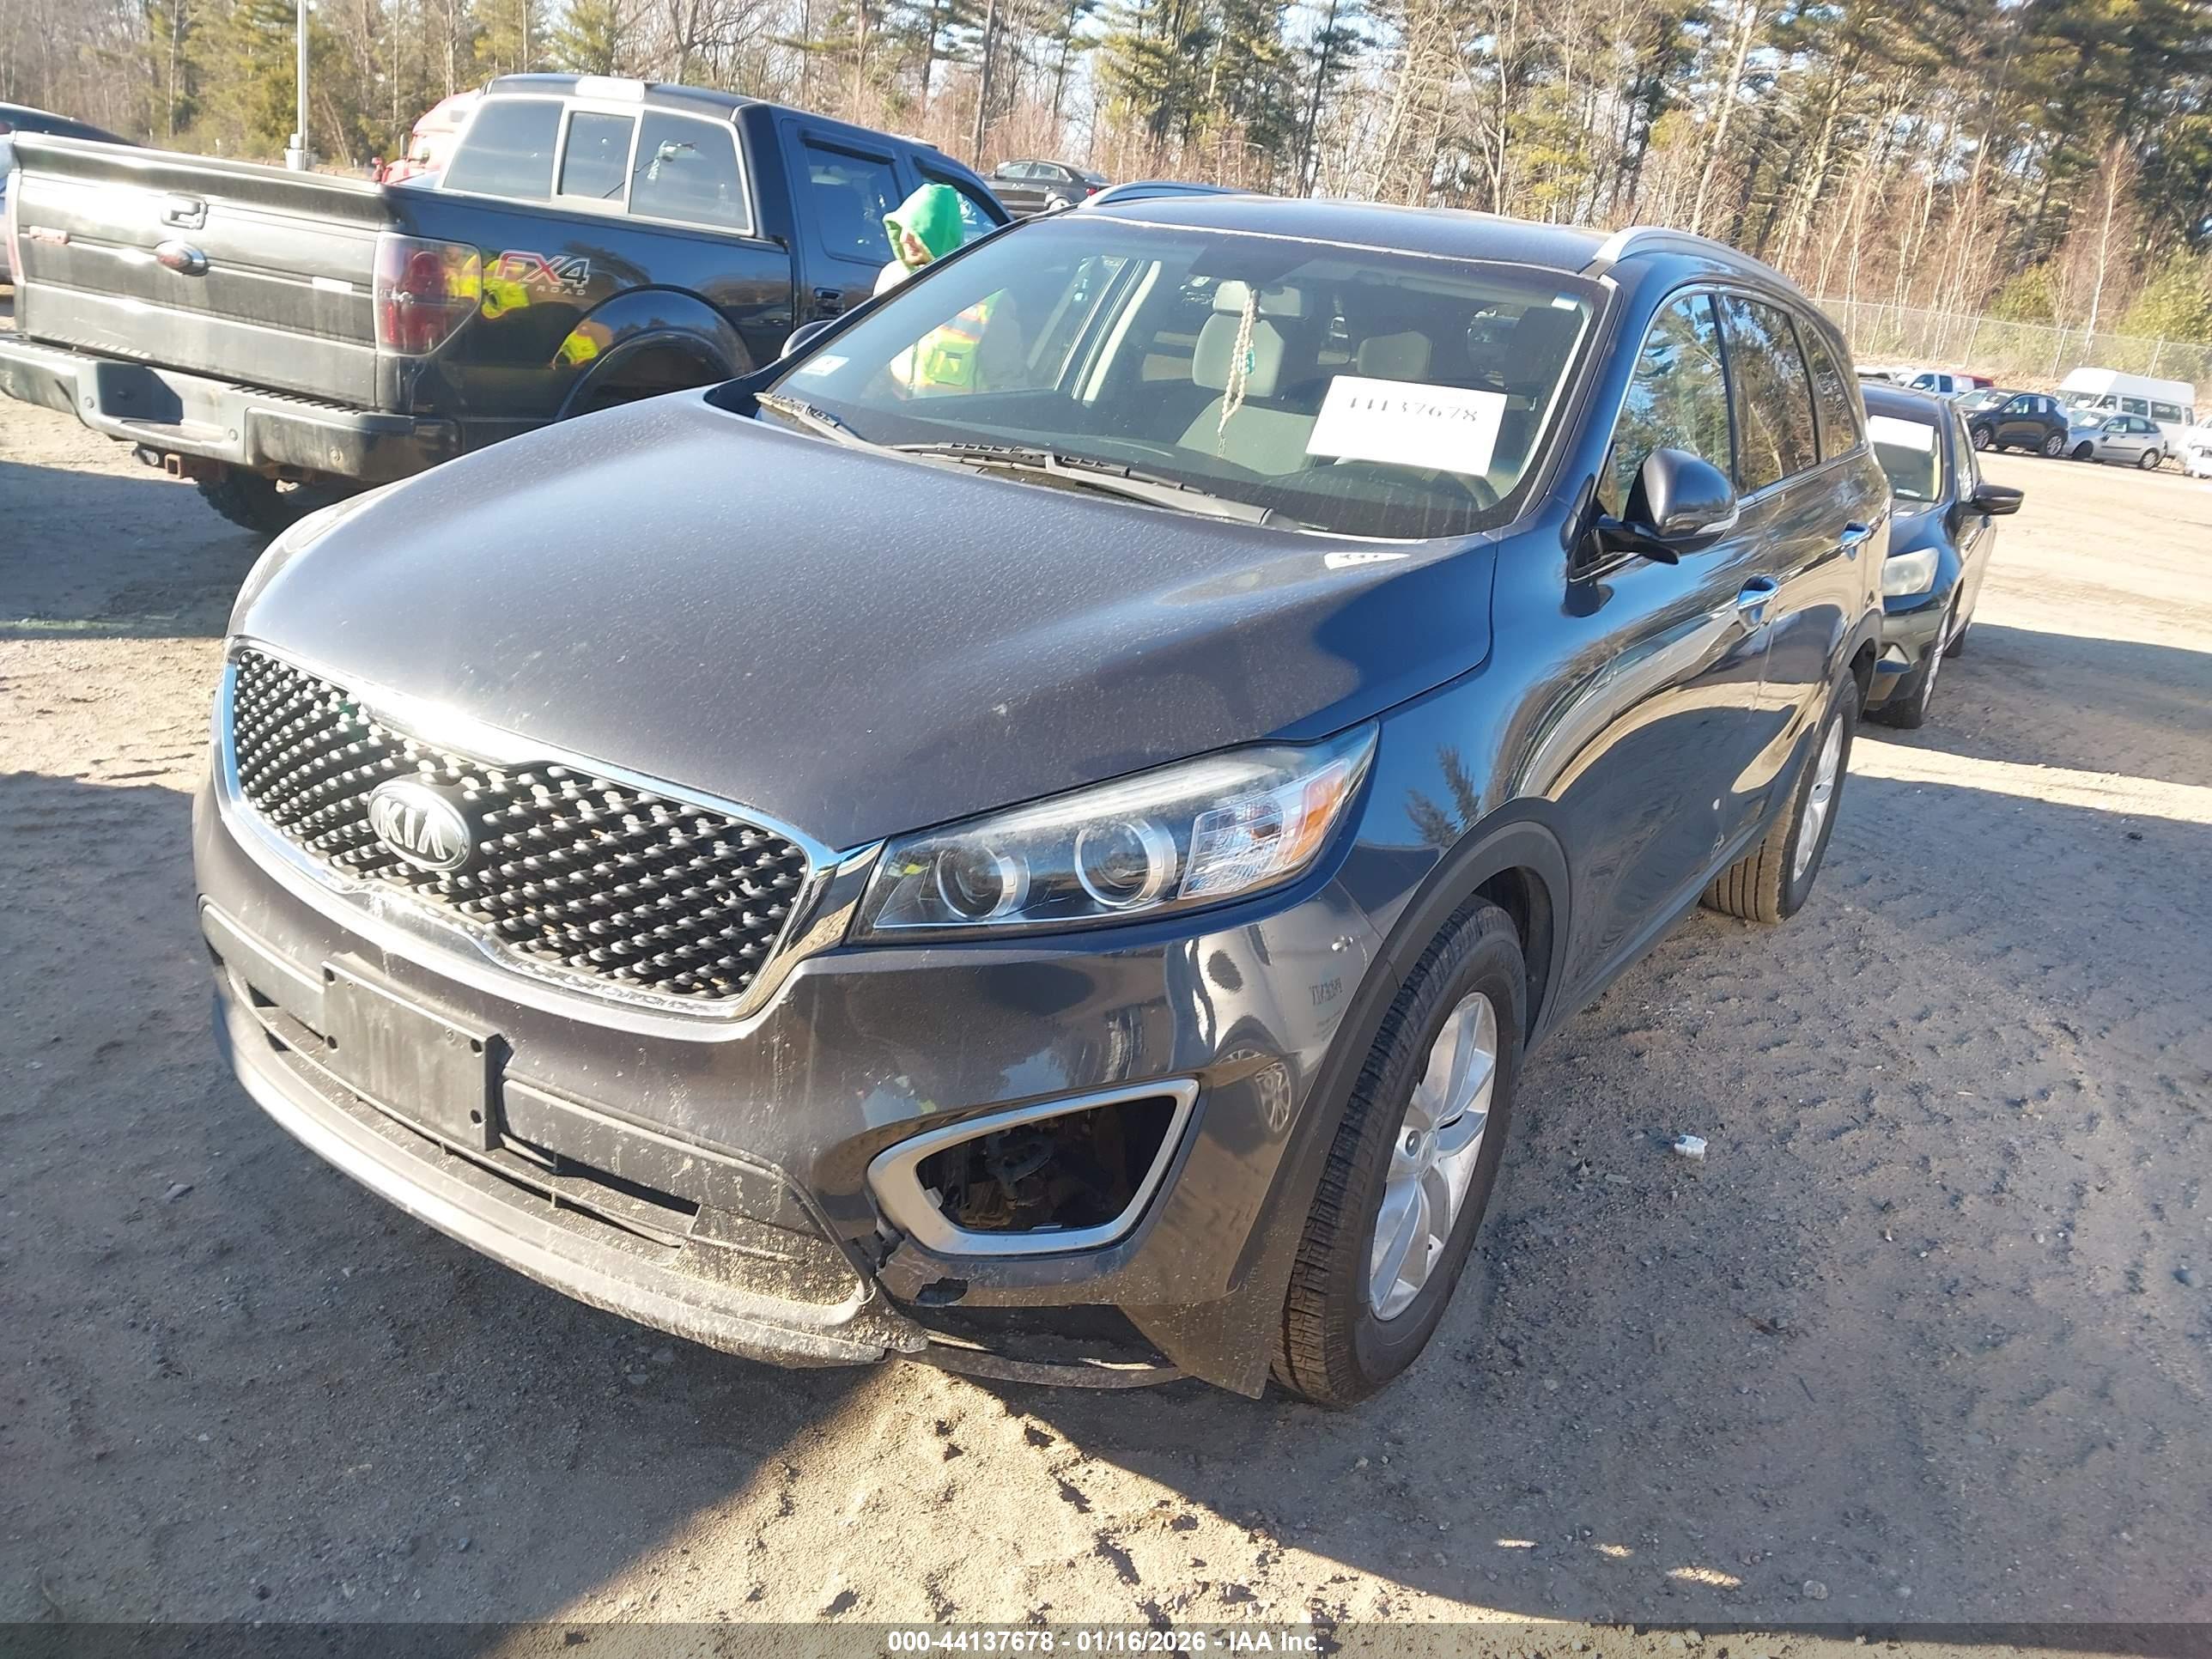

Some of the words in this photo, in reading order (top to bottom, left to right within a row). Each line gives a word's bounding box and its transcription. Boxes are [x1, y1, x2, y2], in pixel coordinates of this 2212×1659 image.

[495, 249, 591, 289] FX4
[535, 284, 586, 296] ROAD
[379, 795, 447, 860] KIA
